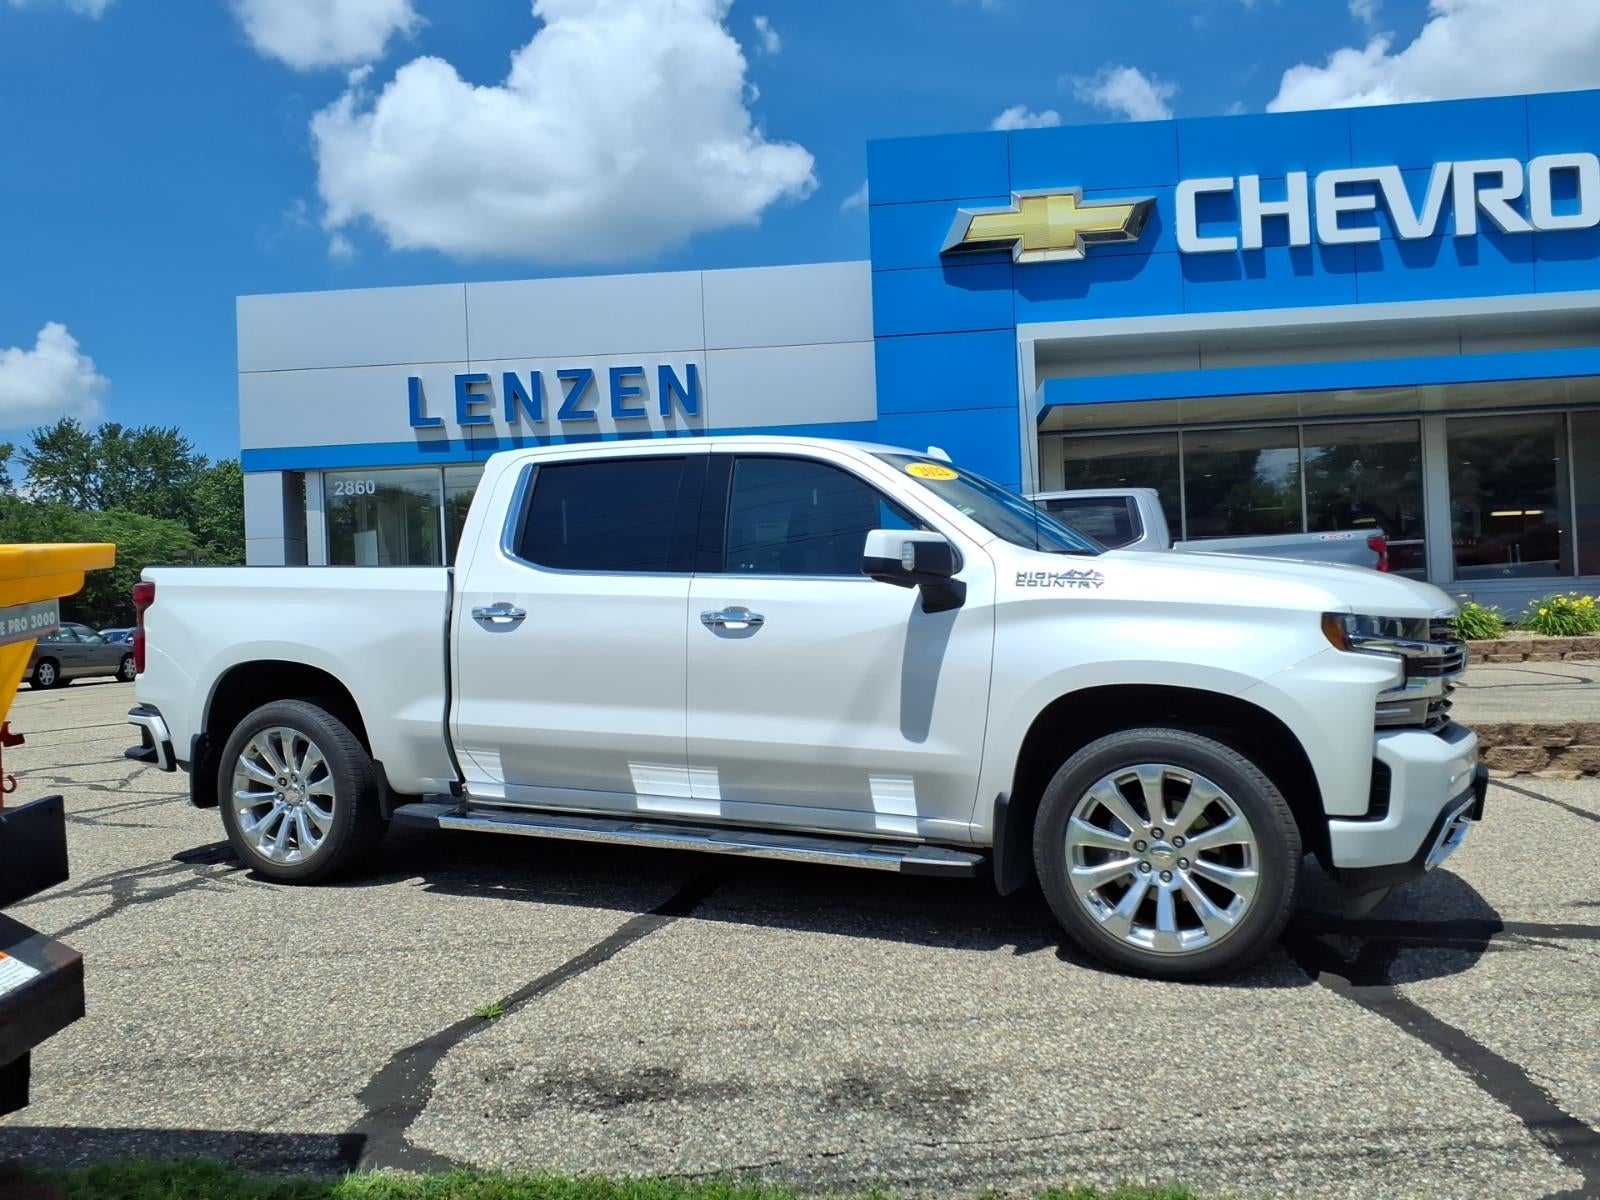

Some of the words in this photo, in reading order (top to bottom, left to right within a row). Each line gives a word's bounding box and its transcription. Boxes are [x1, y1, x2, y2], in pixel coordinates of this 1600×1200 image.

[1176, 152, 1600, 254] CHEVRO
[408, 364, 699, 427] LENZEN
[334, 479, 376, 496] 2860
[1015, 579, 1104, 589] COUNTRY
[1016, 571, 1059, 580] HIGH
[8, 616, 28, 634] PRO
[30, 611, 55, 629] 3000
